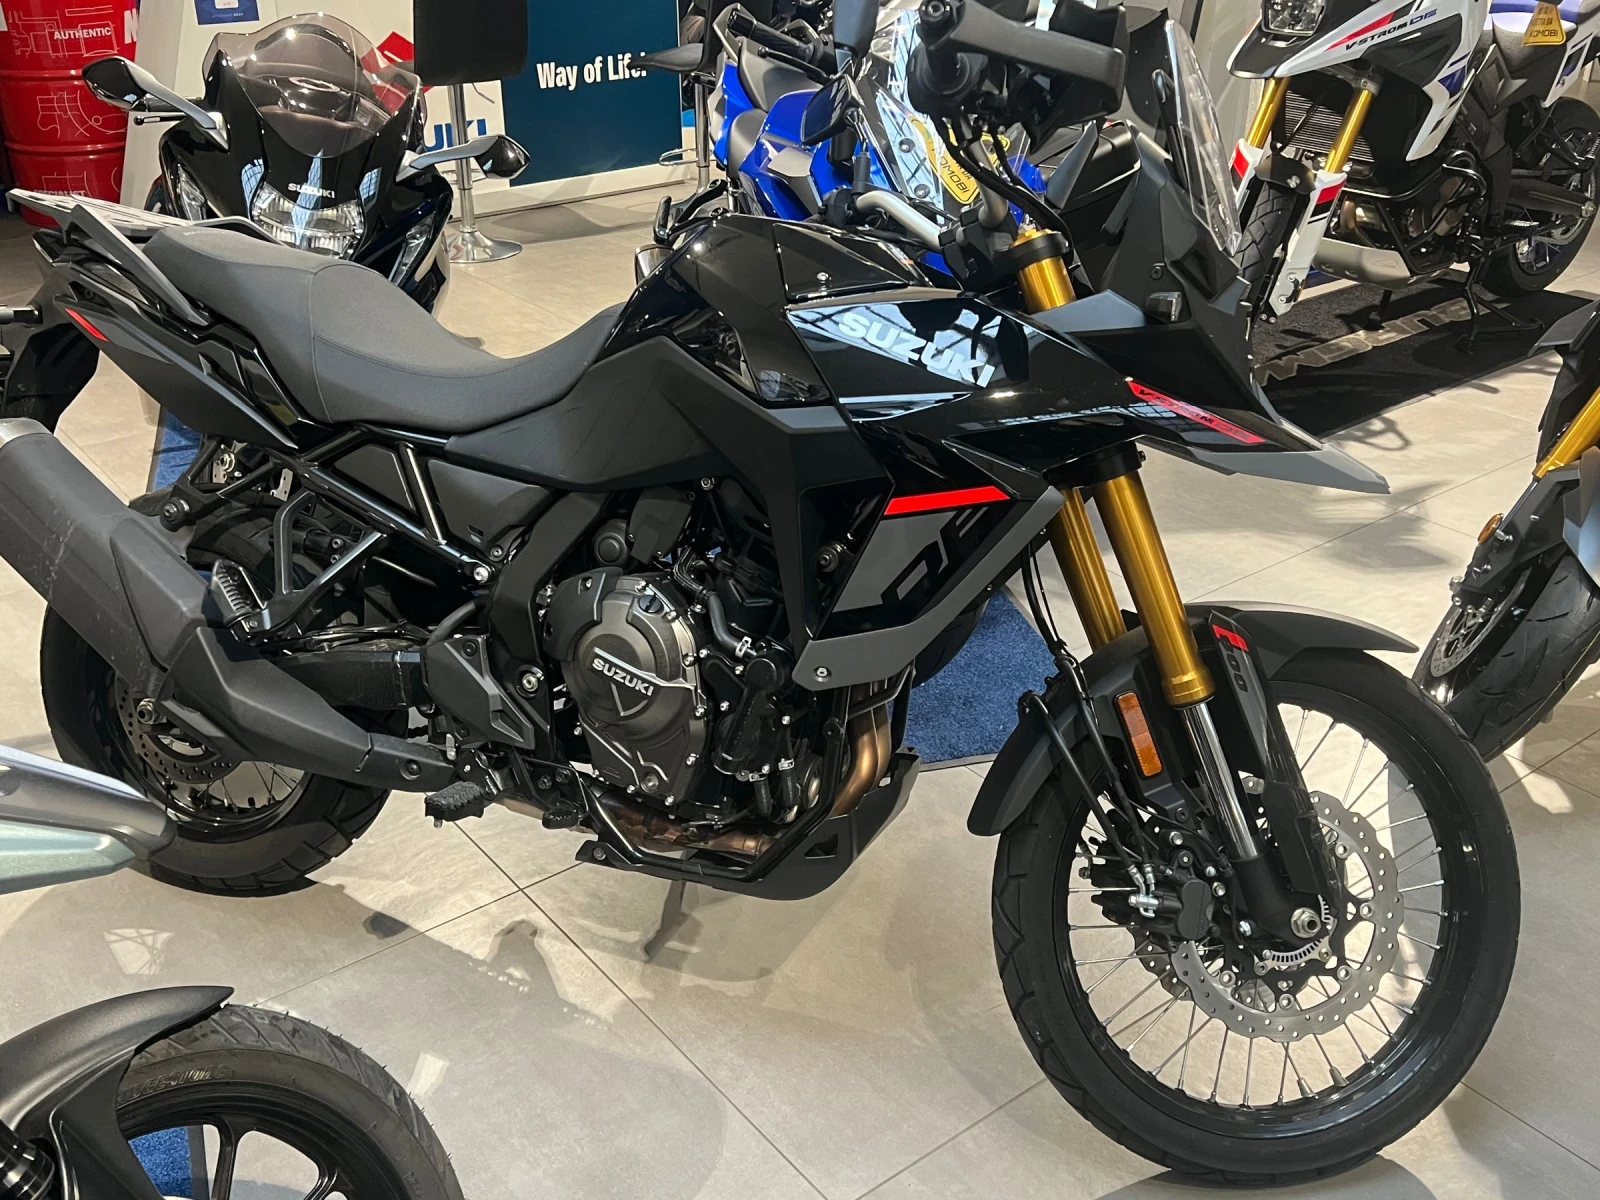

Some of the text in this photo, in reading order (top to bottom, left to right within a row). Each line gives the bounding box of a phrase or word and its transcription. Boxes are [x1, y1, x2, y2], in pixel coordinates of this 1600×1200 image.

[53, 26, 112, 40] AUTHENTIC
[1345, 20, 1408, 51] V-STROM
[536, 61, 578, 91] Way
[583, 55, 604, 84] of
[287, 182, 336, 199] SUZUKI
[939, 156, 970, 194] OMOBI
[838, 312, 997, 388] SUZUKI
[591, 657, 655, 697] SUZUKI
